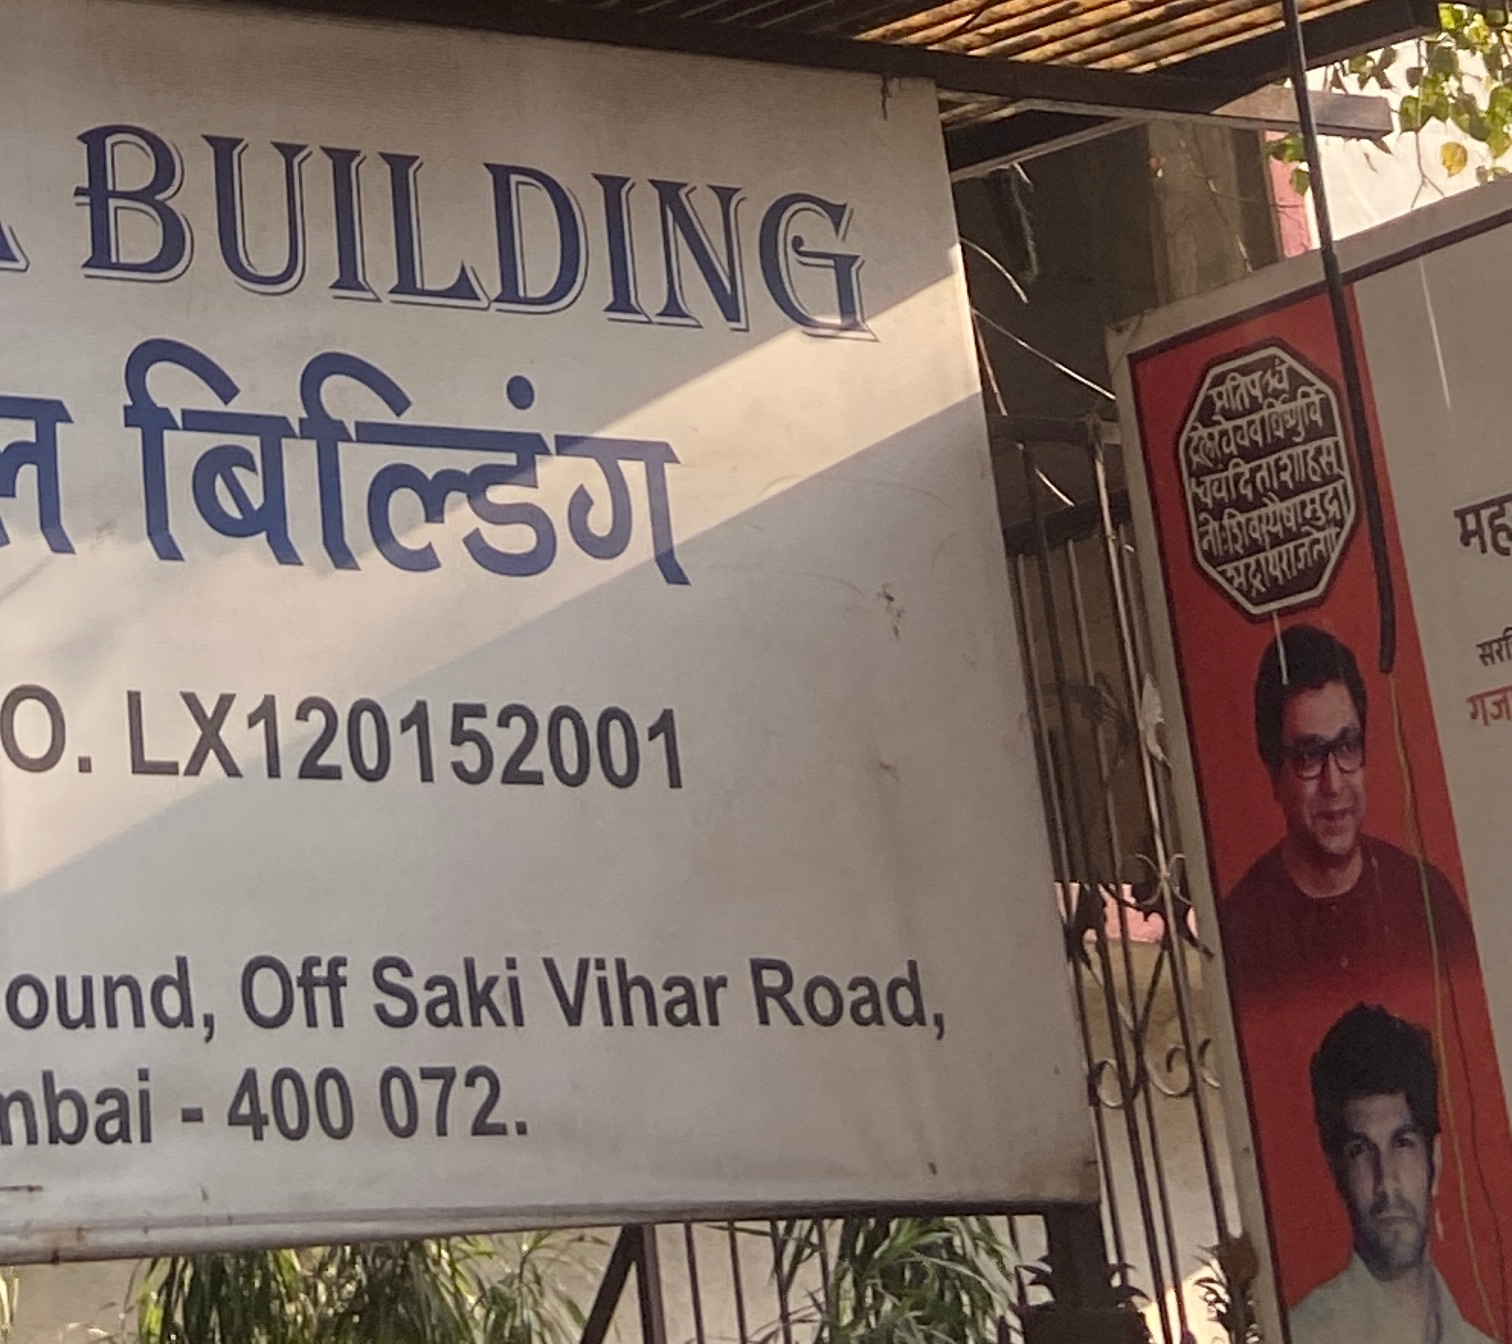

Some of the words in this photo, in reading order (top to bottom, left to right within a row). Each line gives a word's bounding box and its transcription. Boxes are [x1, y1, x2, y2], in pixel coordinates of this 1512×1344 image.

[73, 124, 881, 342] BUILDING
[123, 336, 691, 585] बिल्डिंग
[126, 690, 686, 790] LX120152001
[238, 954, 349, 1031] Off
[371, 954, 527, 1031] Saki
[541, 955, 728, 1031] Vihar
[749, 957, 948, 1041] Road,
[179, 1105, 205, 1125] -
[225, 1066, 355, 1142] 400
[379, 1063, 530, 1139] 072.
